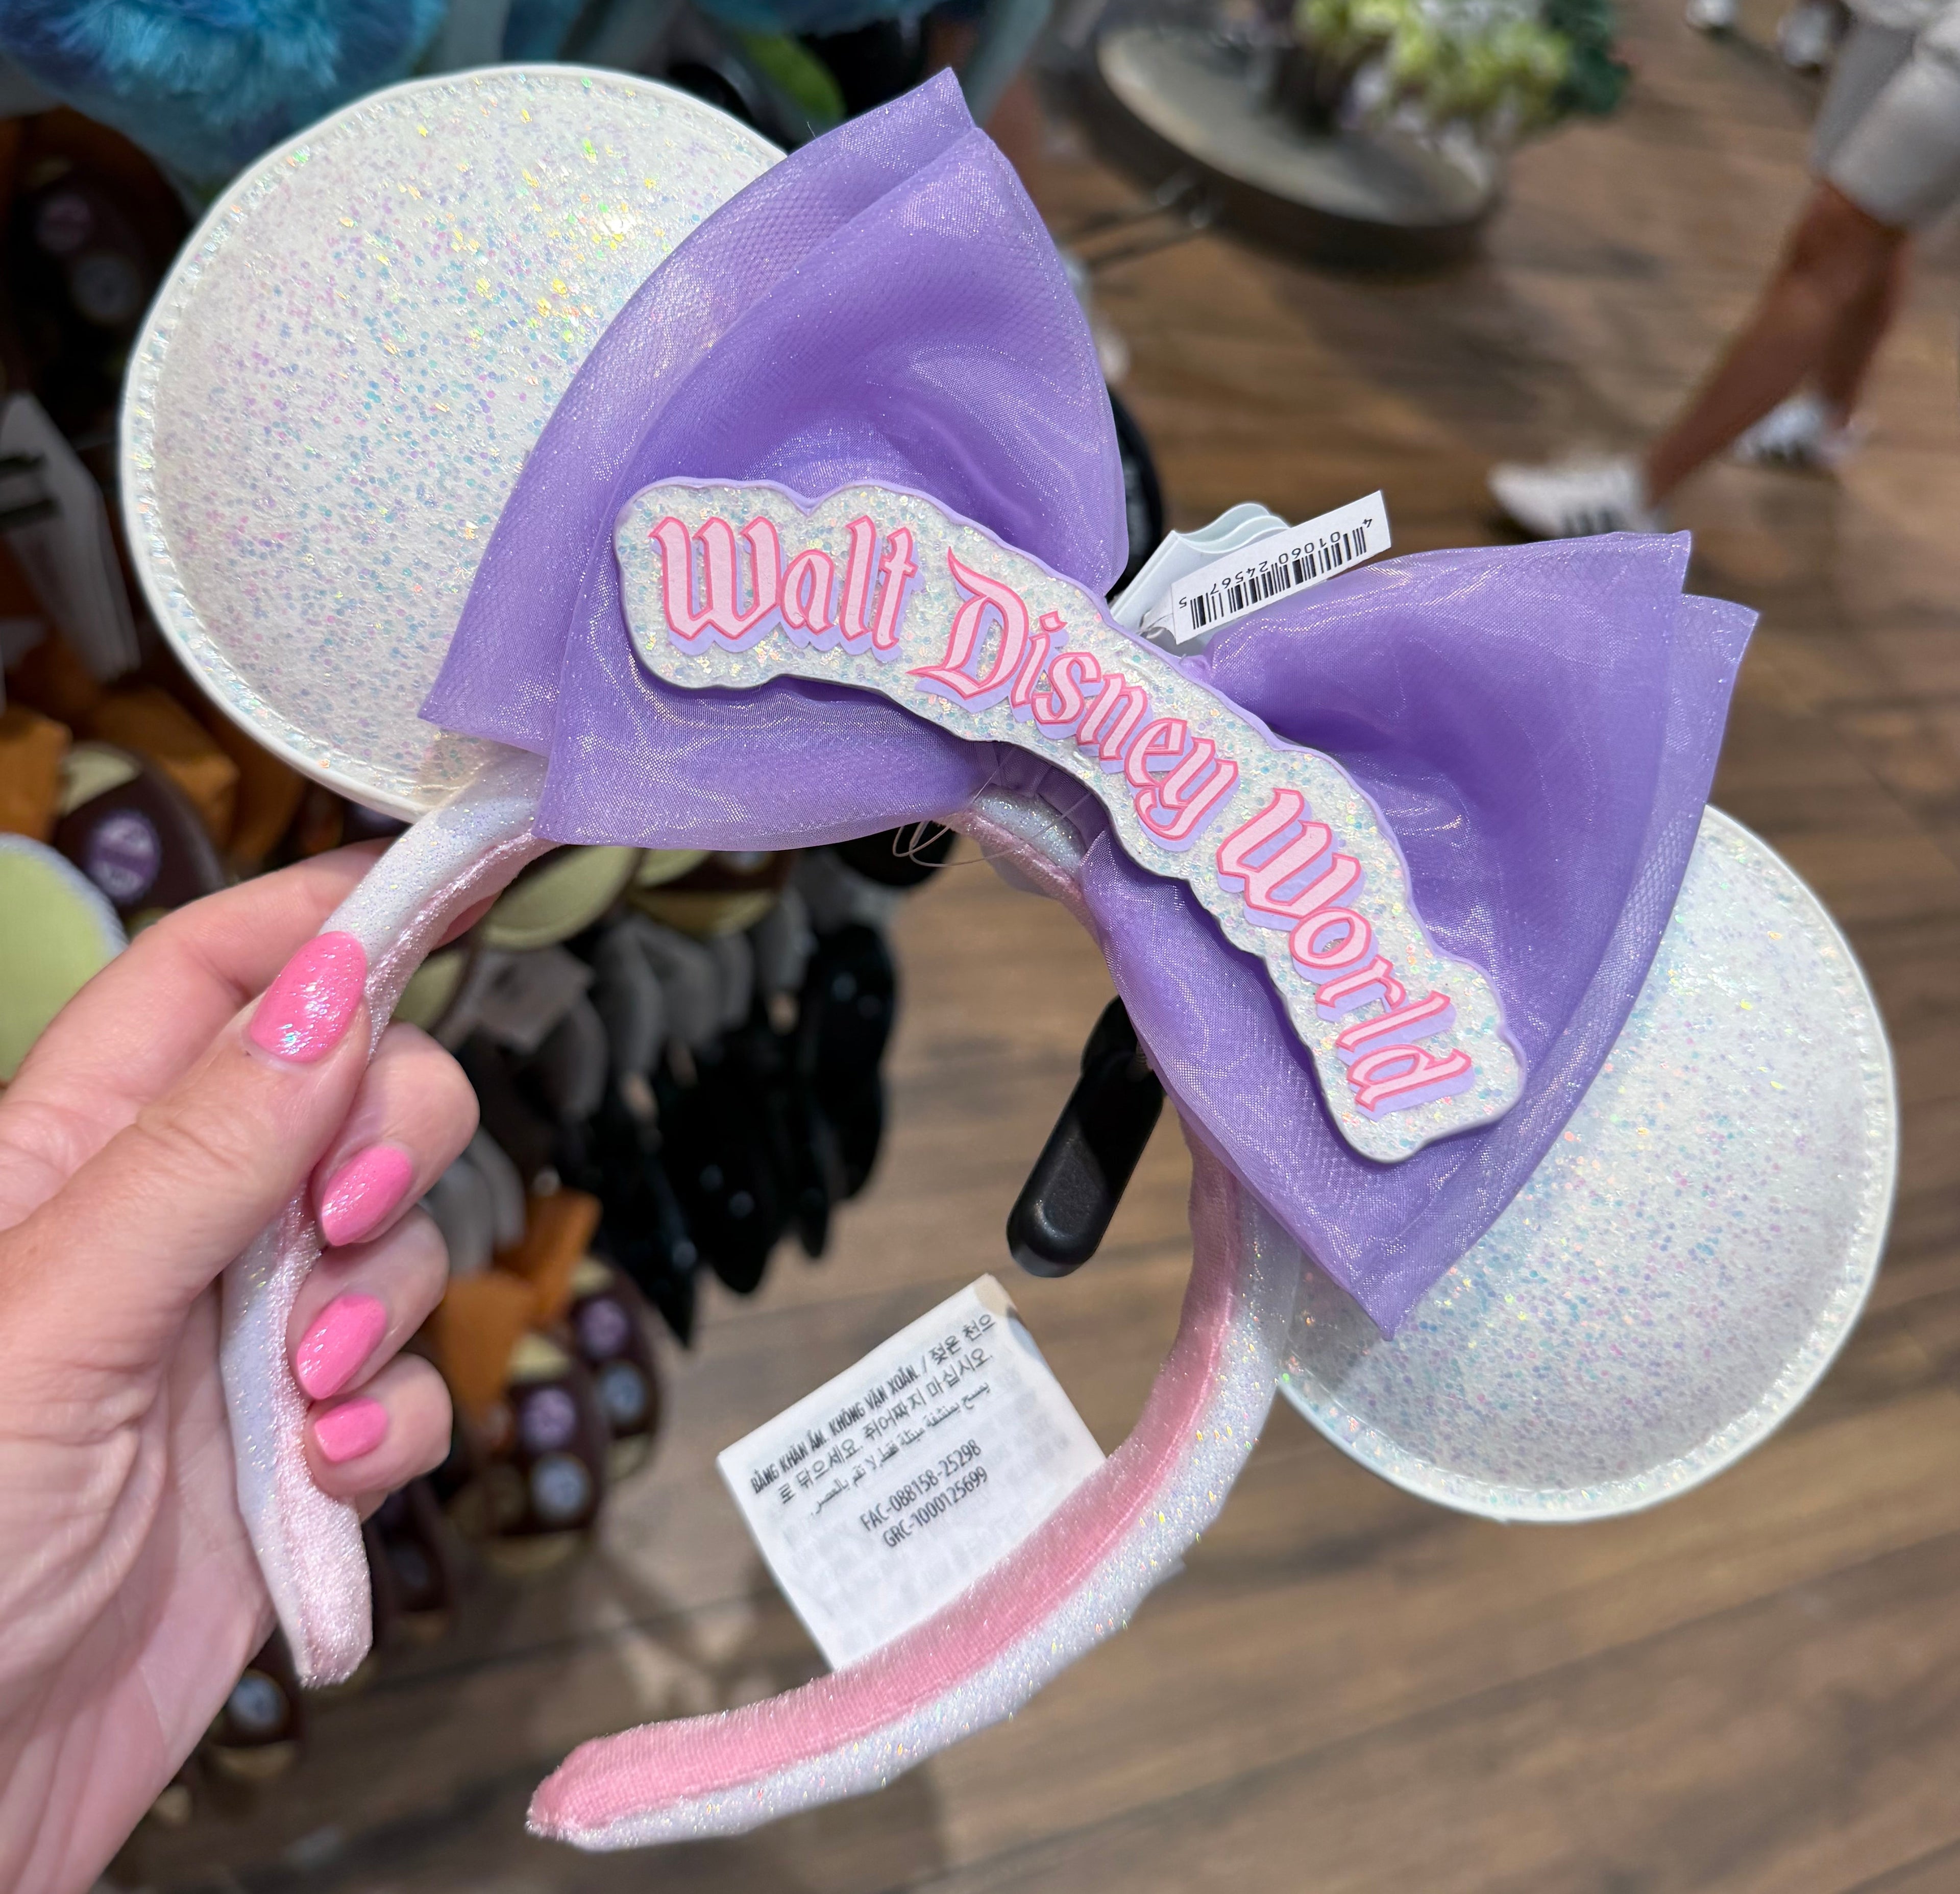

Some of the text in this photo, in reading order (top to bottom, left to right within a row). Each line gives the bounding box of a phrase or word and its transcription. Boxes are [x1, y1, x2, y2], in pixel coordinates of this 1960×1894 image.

[1179, 518, 1373, 609] 4 01060 24567 5
[649, 515, 1472, 1111] Walt Disney World
[778, 1484, 795, 1505] 로
[863, 1389, 927, 1441] 쥐어짜지
[925, 1348, 993, 1398] 마십시오.
[828, 1401, 865, 1437] KHÔNG
[928, 1335, 961, 1365] 젖은
[962, 1314, 995, 1342] 천으
[859, 1439, 982, 1532] FAC-088158-25298
[882, 1466, 988, 1548] GRC-1000125699
